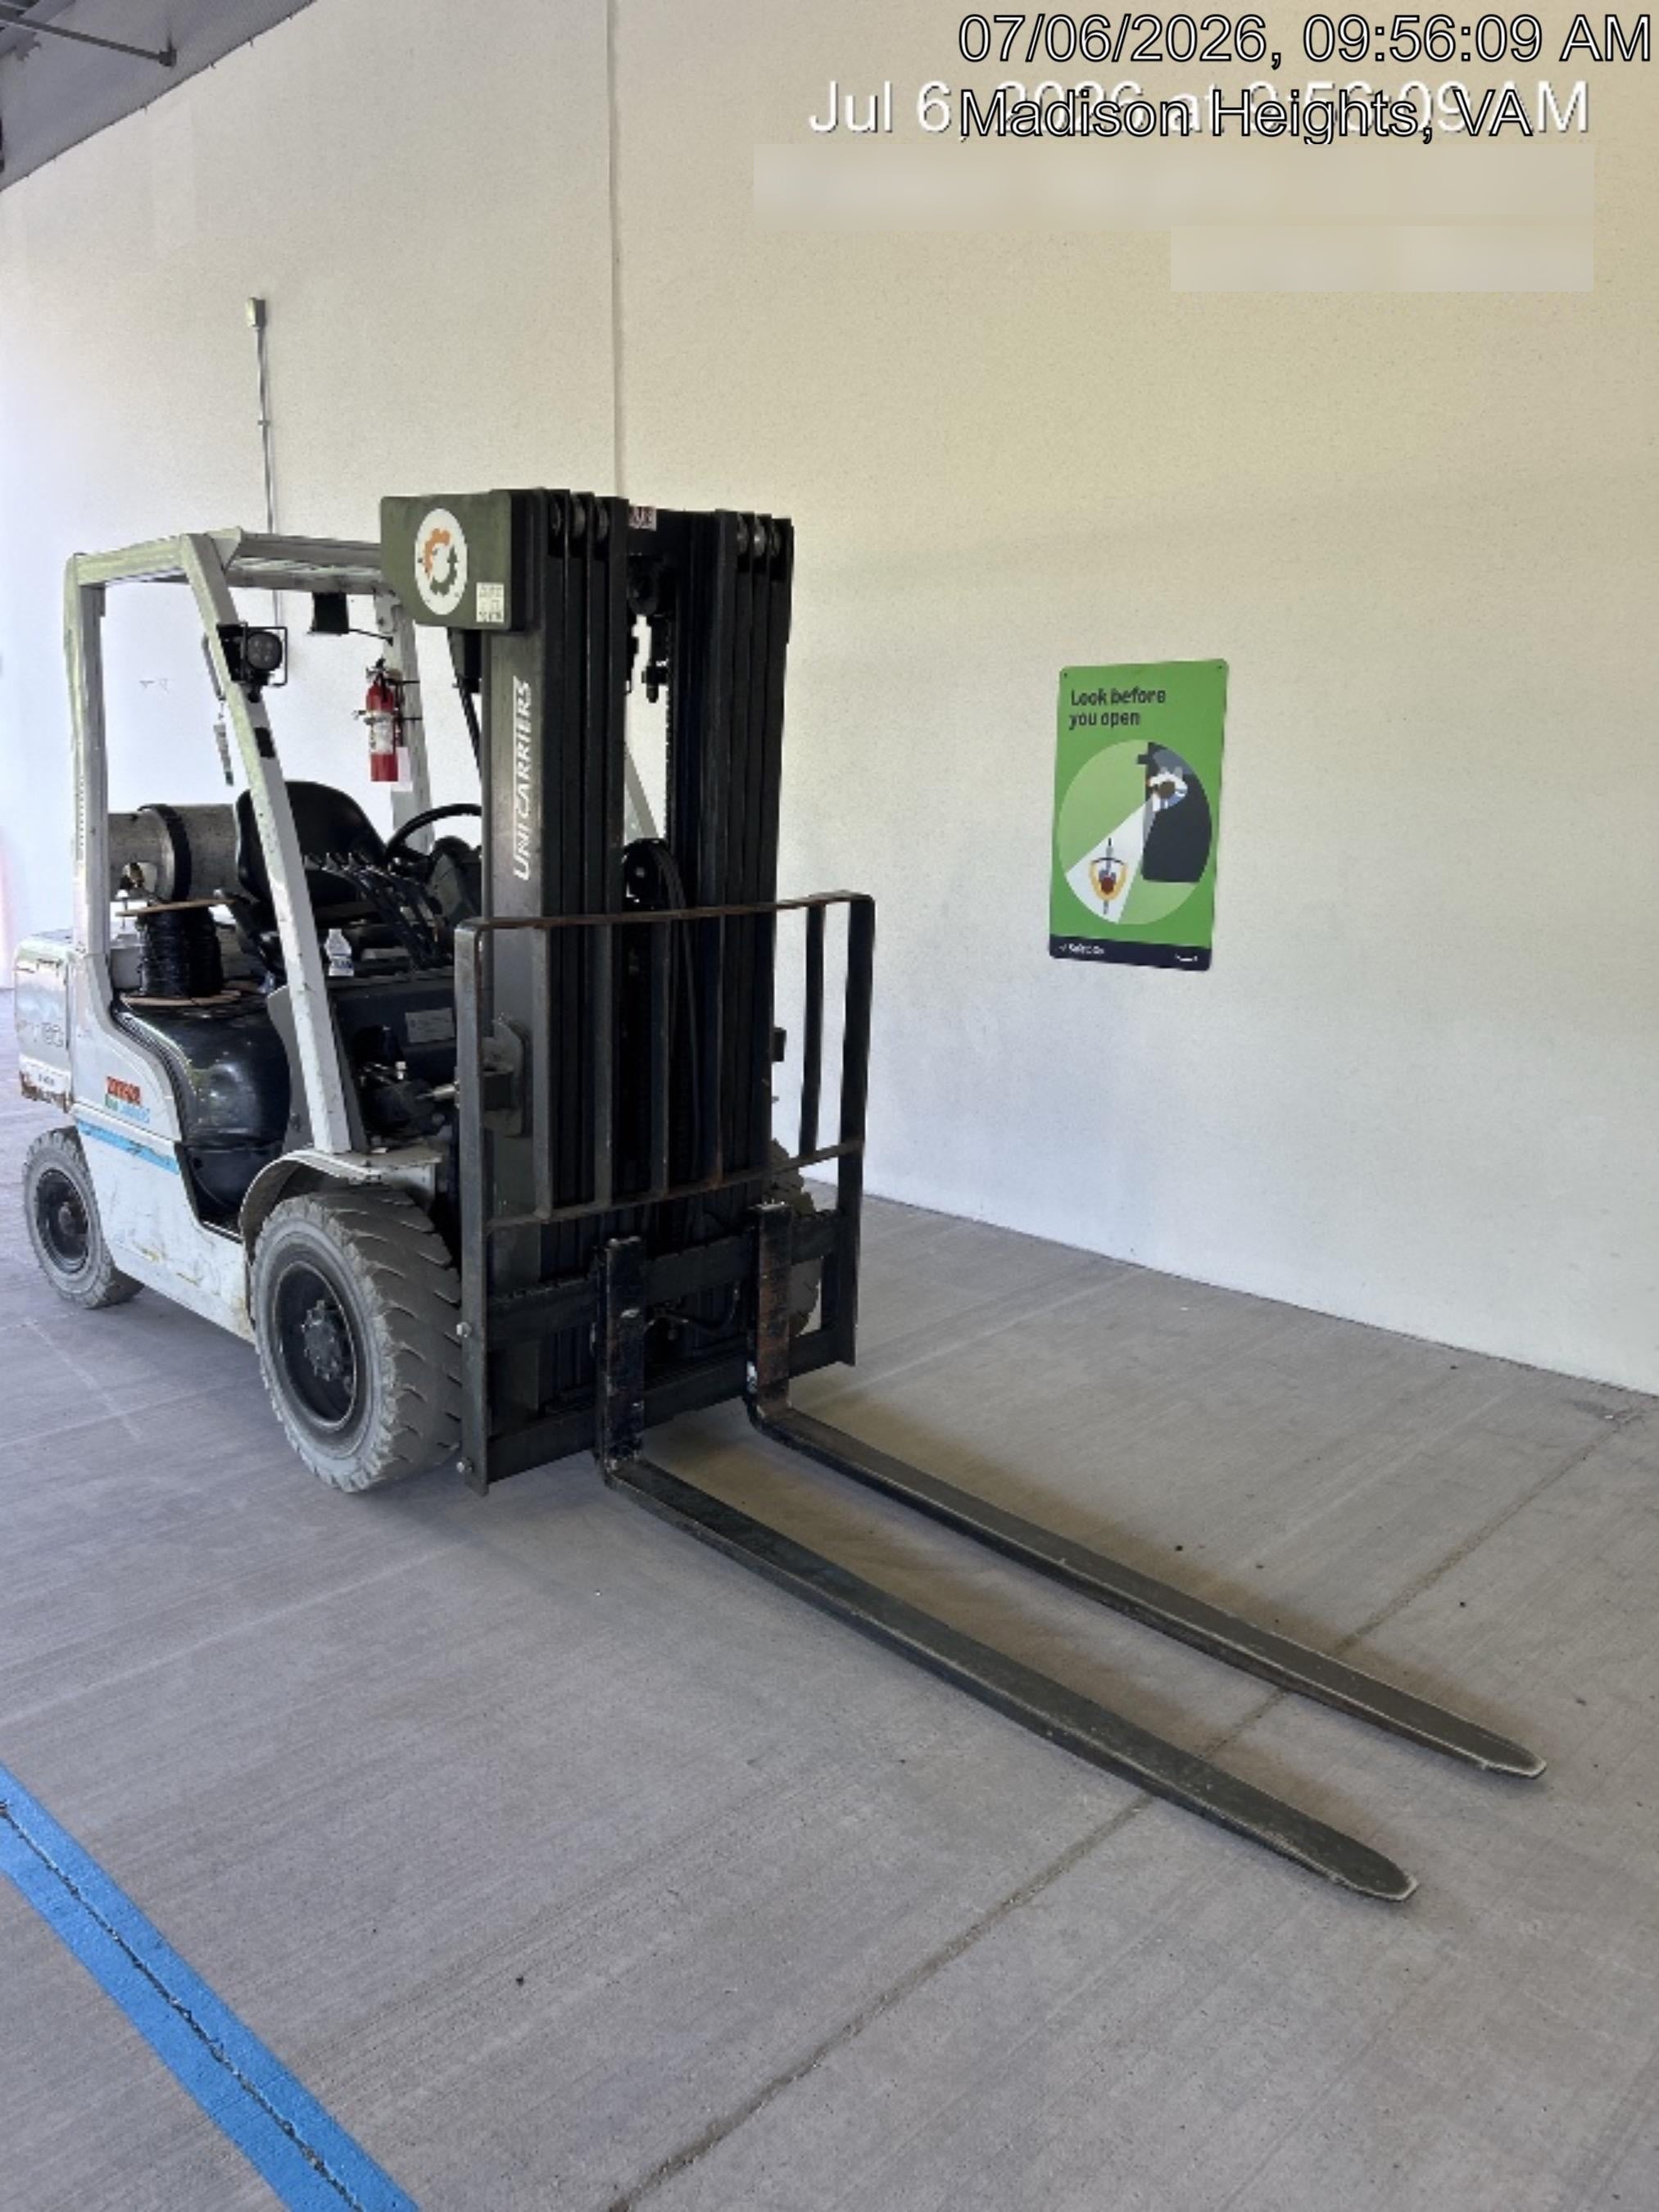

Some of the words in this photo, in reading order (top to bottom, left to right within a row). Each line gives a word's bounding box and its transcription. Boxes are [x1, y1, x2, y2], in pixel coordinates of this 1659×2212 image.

[1071, 687, 1107, 706] Look
[1110, 686, 1166, 705] before
[1068, 711, 1097, 731] you
[1100, 711, 1140, 728] open
